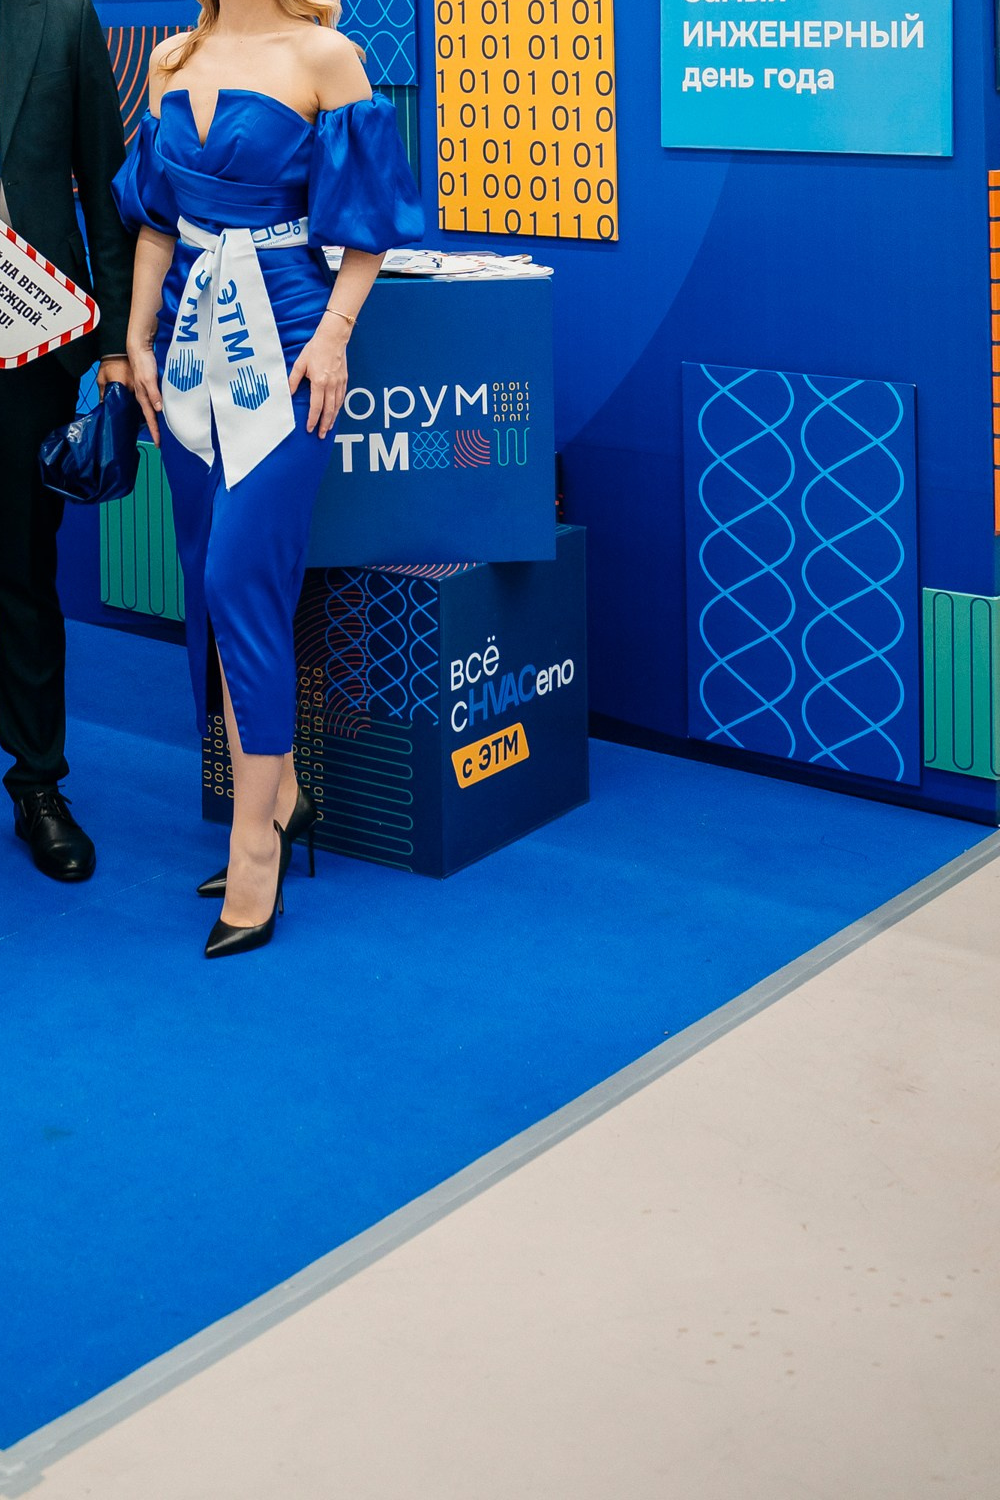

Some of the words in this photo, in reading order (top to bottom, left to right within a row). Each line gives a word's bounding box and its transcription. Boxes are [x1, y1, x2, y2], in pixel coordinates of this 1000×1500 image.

[683, 13, 924, 48] ИНЖЕНЕРНЫЙ
[682, 68, 754, 92] день
[764, 69, 834, 94] года
[0, 259, 20, 280] НА
[17, 274, 63, 316] ВЕТРУ!
[218, 280, 255, 363] ЭТМ
[343, 383, 488, 428] орум
[334, 432, 409, 473] ТМ
[451, 635, 500, 691] всё
[479, 730, 518, 771] ЭТМ
